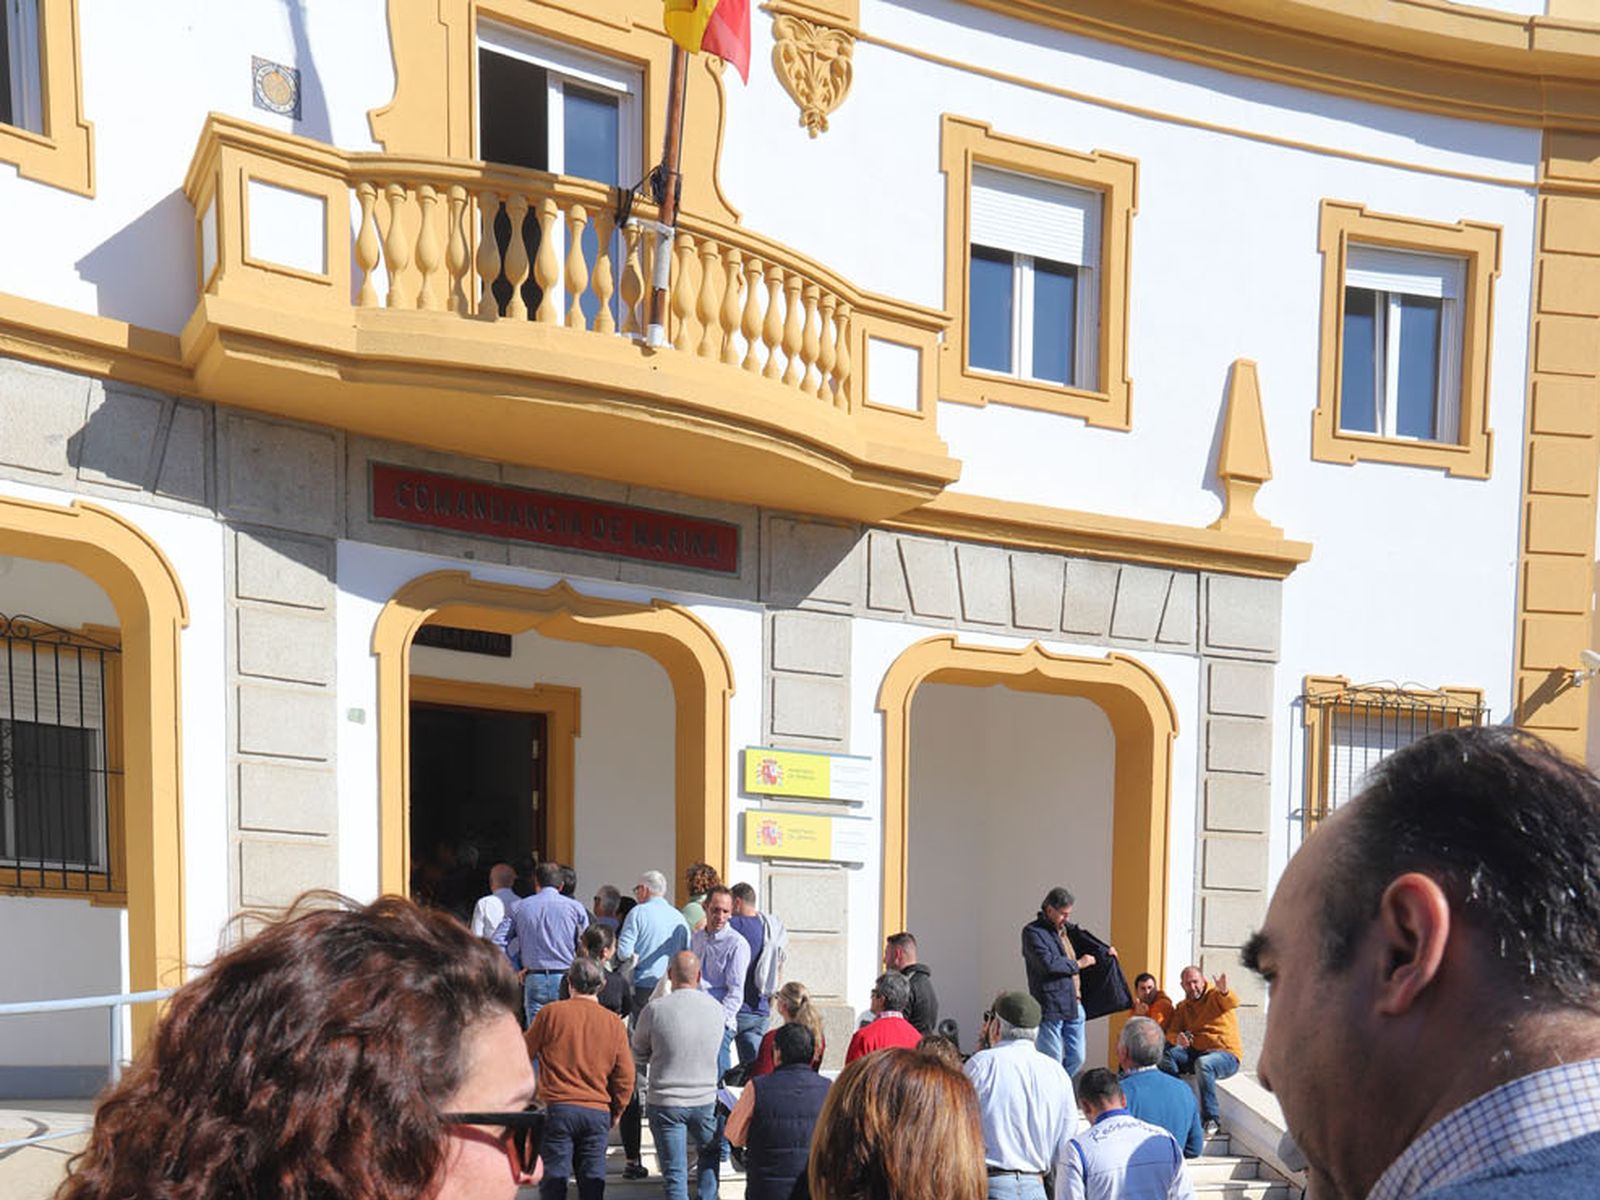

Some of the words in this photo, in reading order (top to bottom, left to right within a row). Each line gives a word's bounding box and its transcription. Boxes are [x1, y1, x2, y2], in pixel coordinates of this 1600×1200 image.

[395, 481, 583, 537] COMANDANCIA
[592, 518, 625, 544] DE
[633, 520, 720, 561] MARINA
